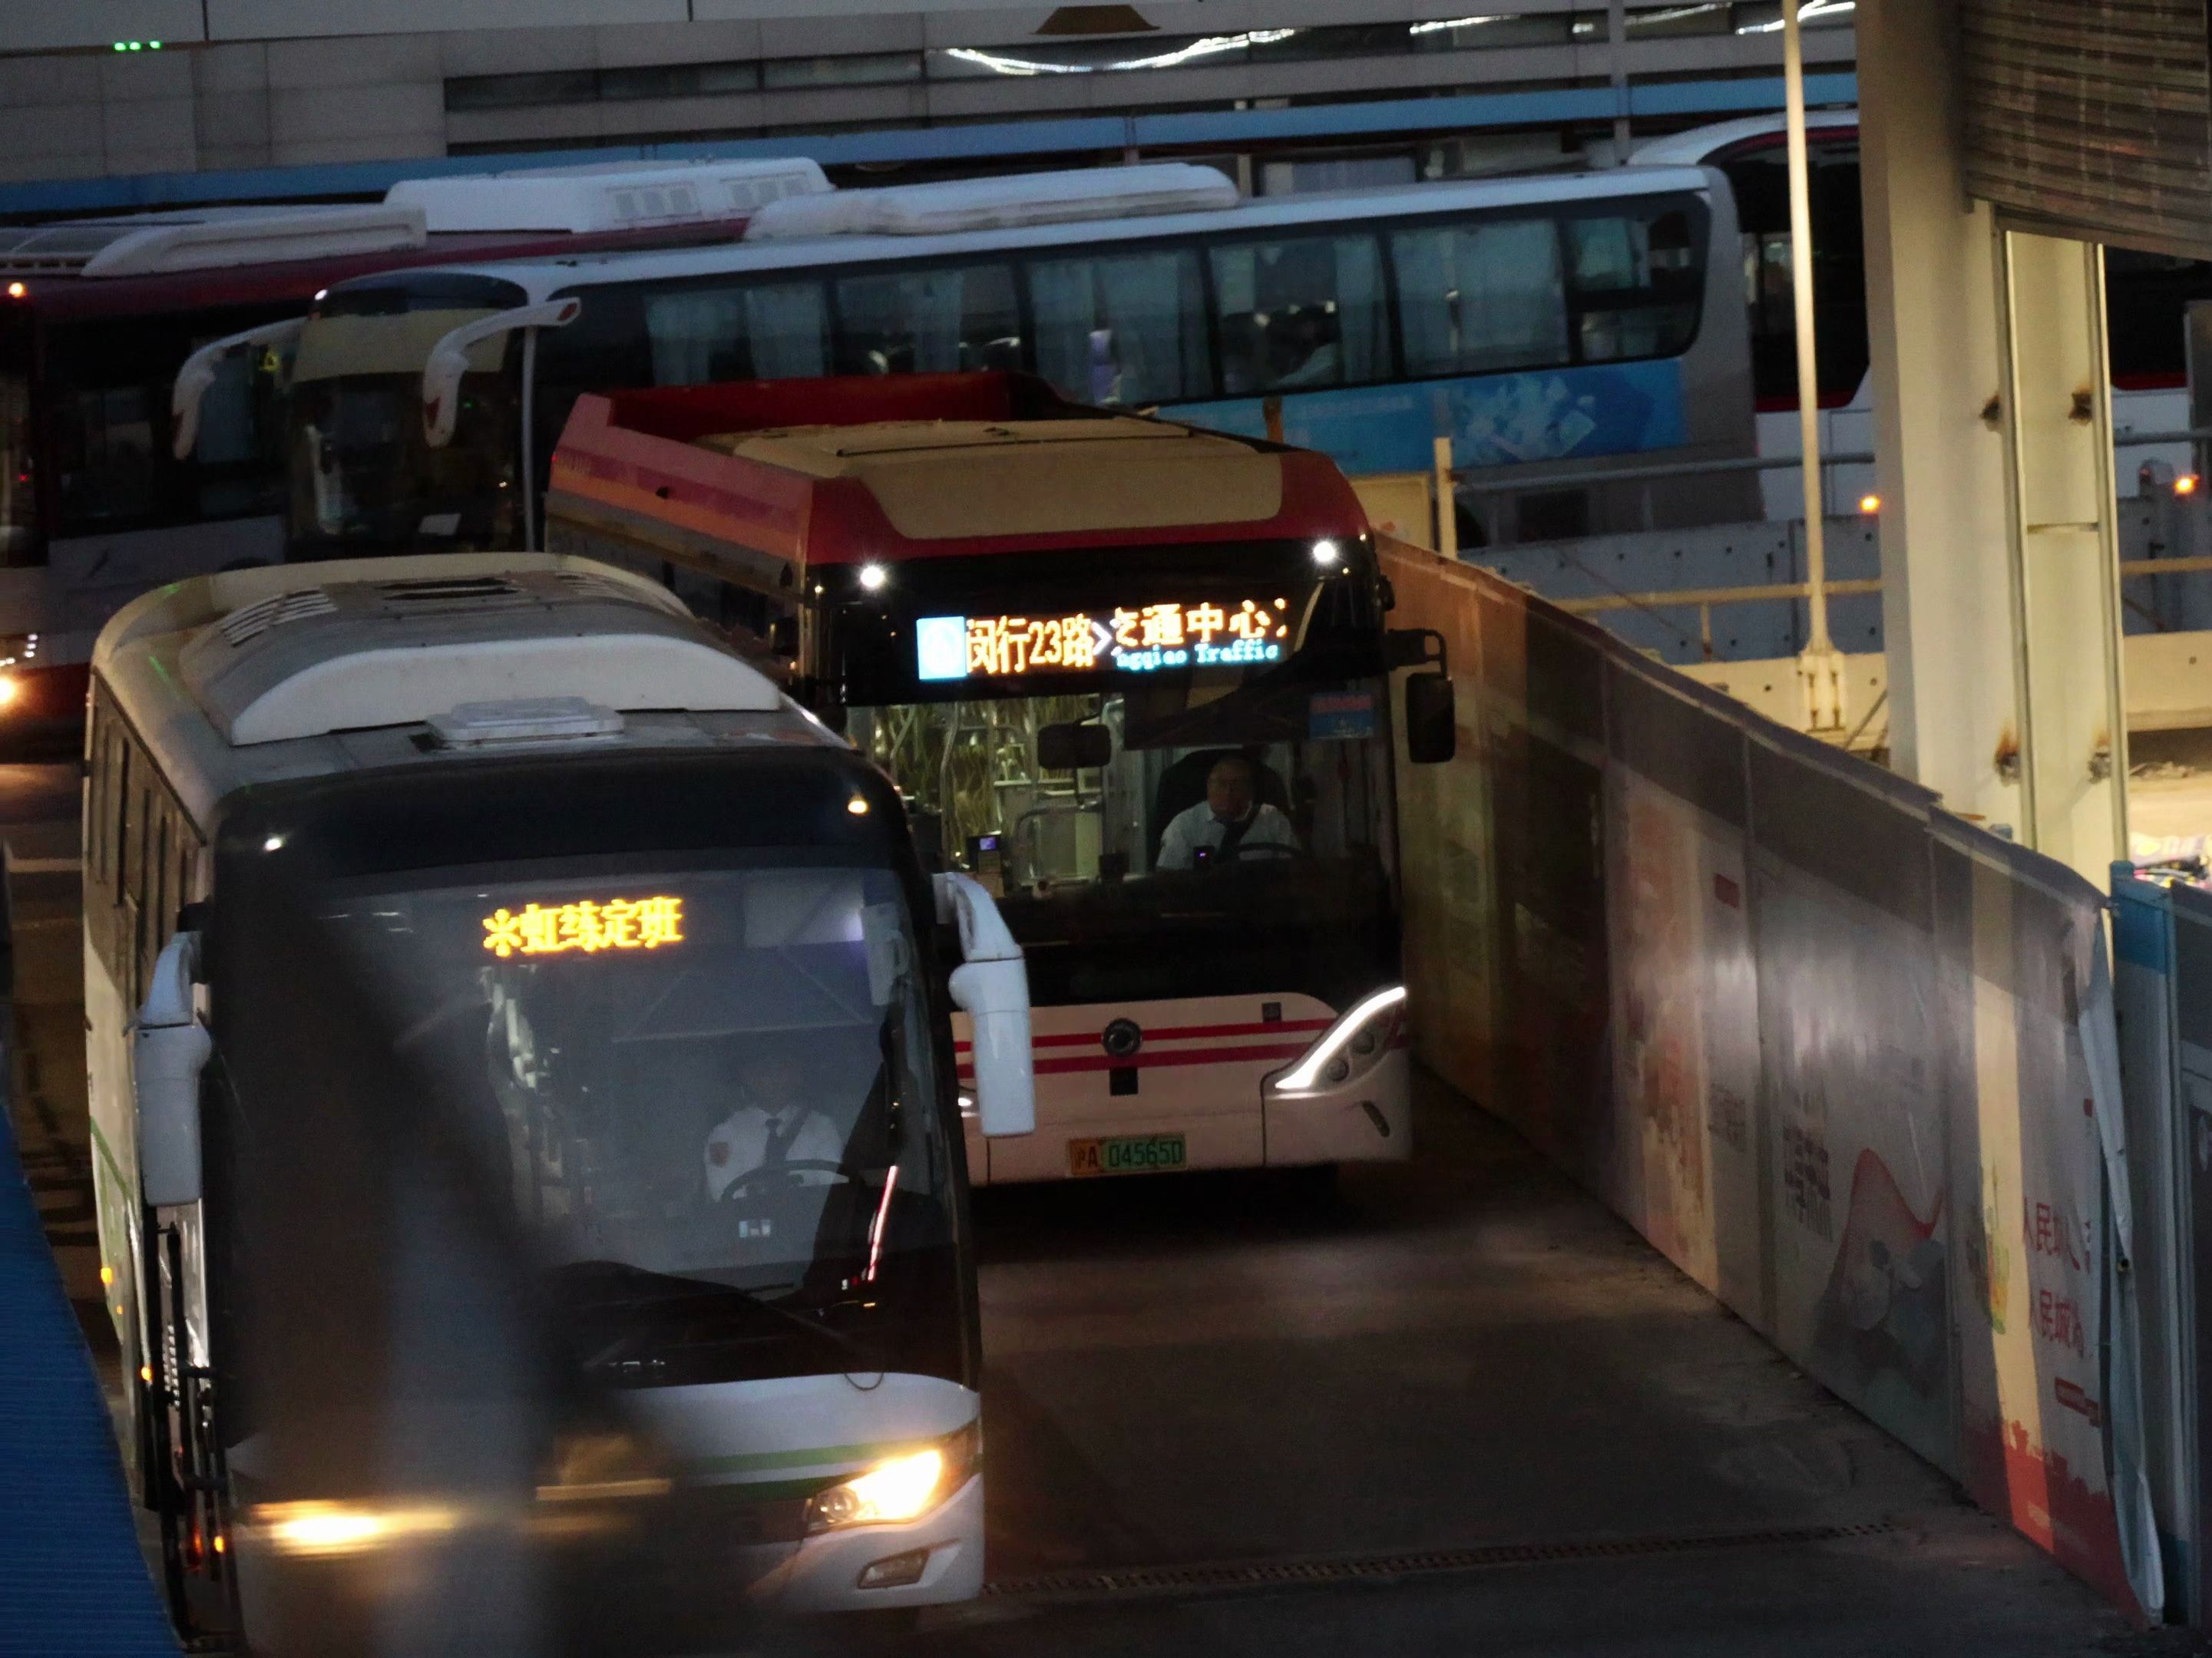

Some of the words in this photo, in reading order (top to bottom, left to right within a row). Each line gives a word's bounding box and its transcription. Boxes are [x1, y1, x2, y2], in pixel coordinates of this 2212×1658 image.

[966, 613, 1094, 674] 闵行23路
[1194, 639, 1278, 663] Traffic
